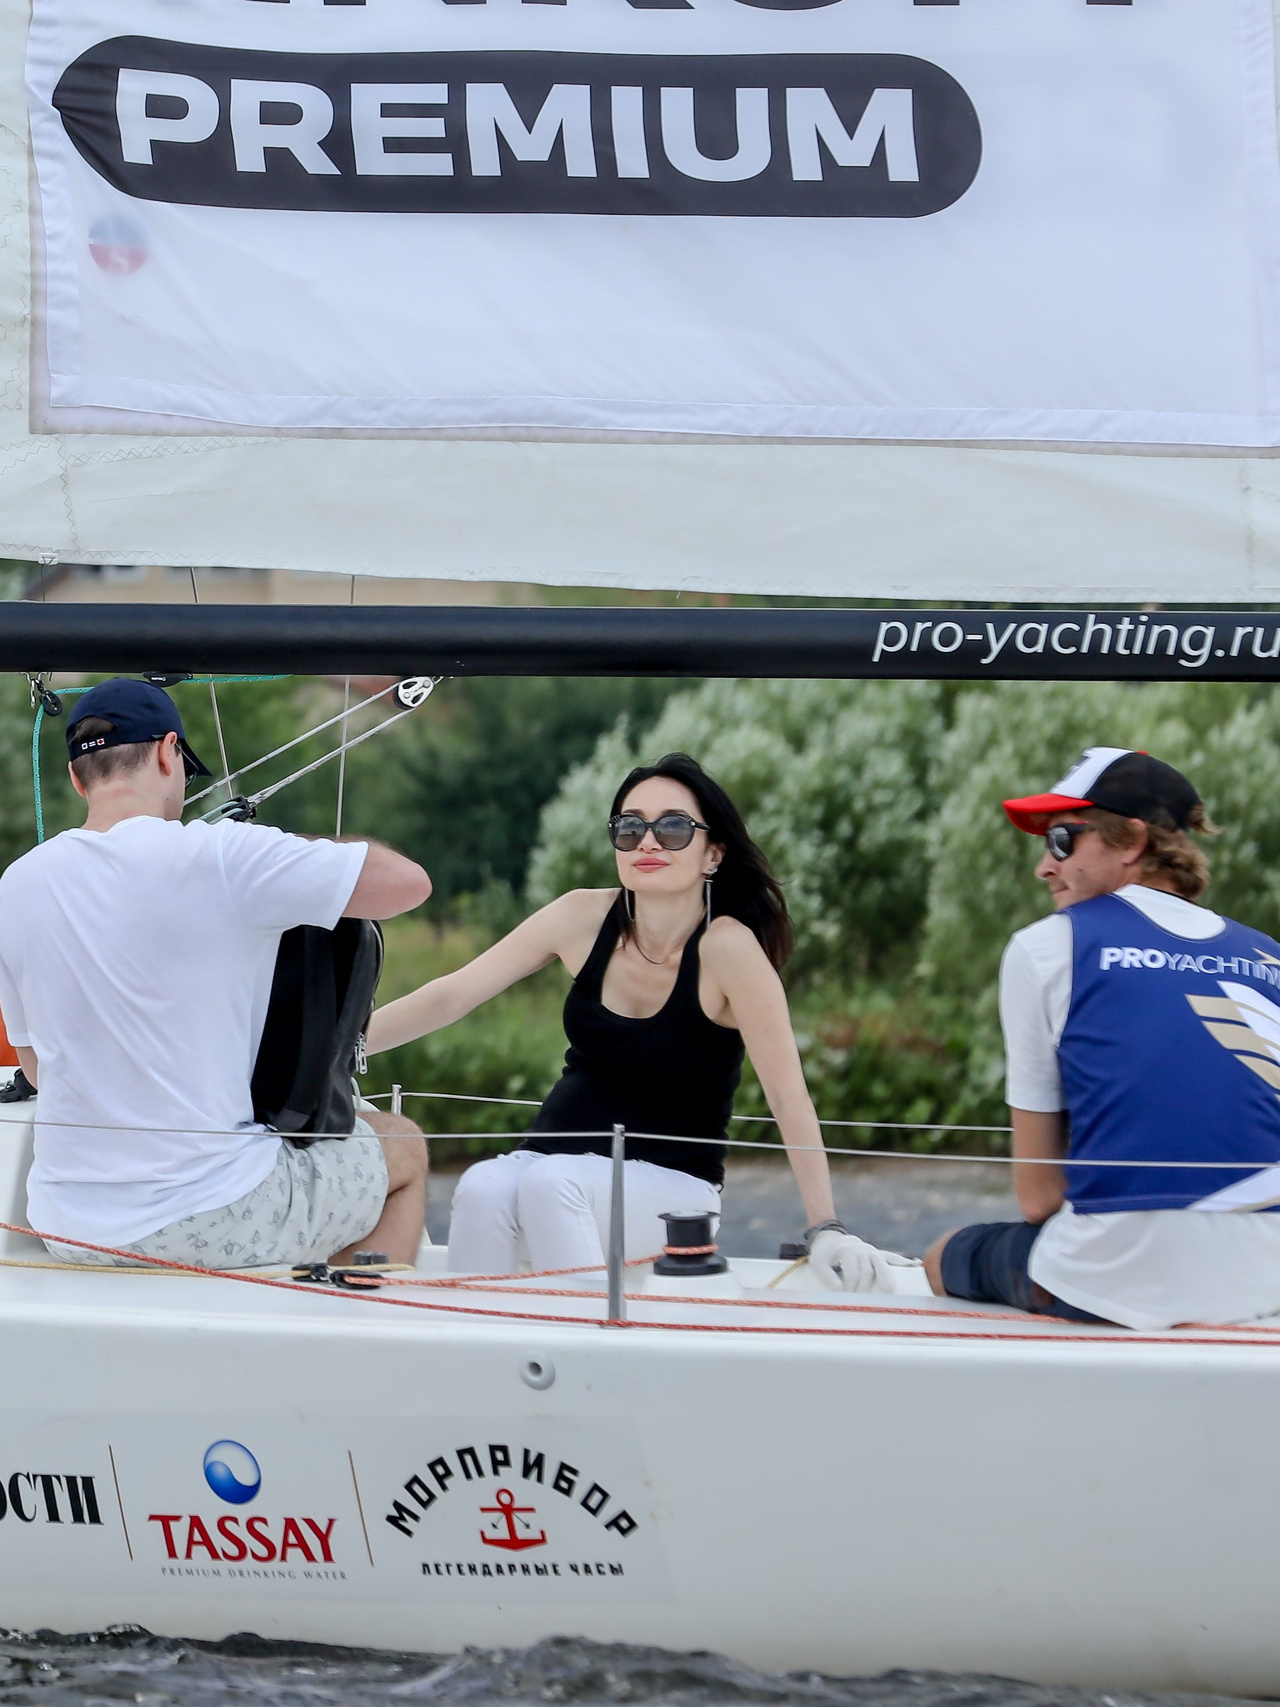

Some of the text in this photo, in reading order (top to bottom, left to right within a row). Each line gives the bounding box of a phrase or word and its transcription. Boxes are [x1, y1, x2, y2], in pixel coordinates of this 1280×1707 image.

[116, 68, 920, 182] PREMIUM
[872, 613, 1280, 668] pro-yachting.ru
[385, 1444, 639, 1538] МОРПРИБОР
[148, 1514, 338, 1563] TASSAY
[161, 1567, 347, 1581] PREMIUM DRINKING WATER
[421, 1562, 625, 1577] ЛЕГЕНДАРНЫЕ ЧАСЫ
